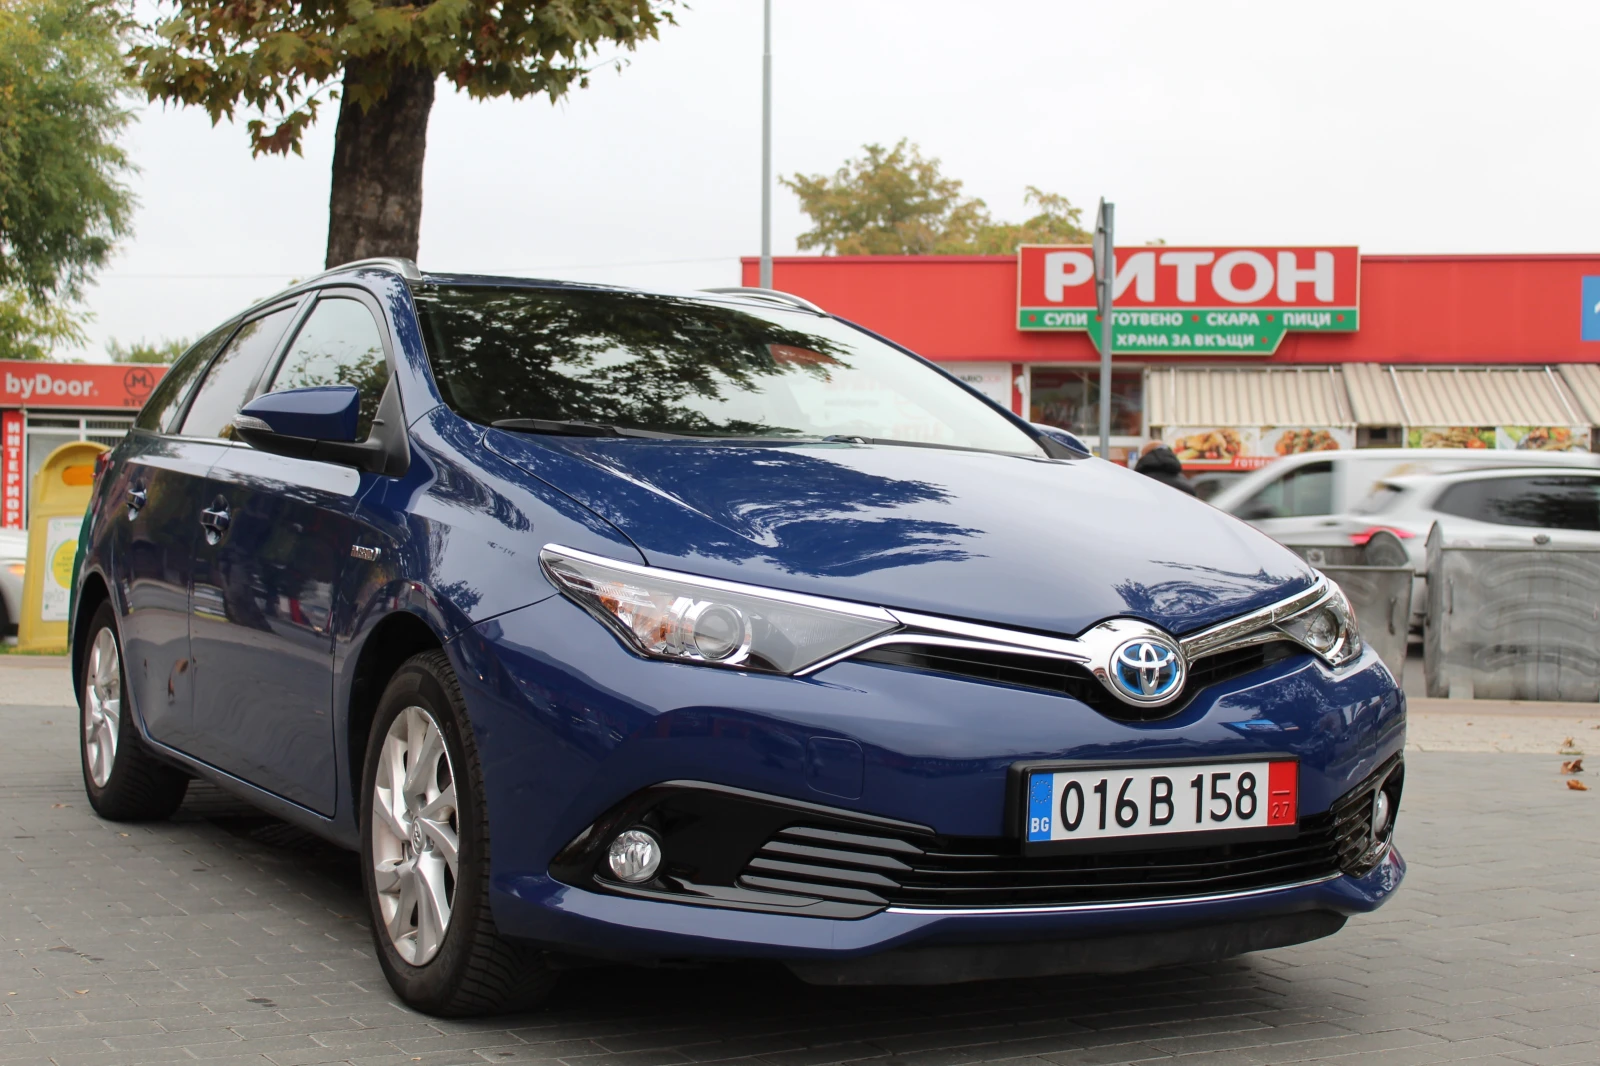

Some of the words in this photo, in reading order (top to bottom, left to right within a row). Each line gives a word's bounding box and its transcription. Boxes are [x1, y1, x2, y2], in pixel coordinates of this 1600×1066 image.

[1044, 251, 1335, 303] РИТОН
[1044, 312, 1088, 326] СУПИ
[1111, 312, 1183, 326] ГОТВЕНО
[1206, 312, 1260, 326] СКАРА
[1283, 312, 1331, 328] ПИЦИ
[1116, 334, 1169, 347] ХРАНА
[1172, 334, 1191, 346] ЗА
[1194, 334, 1254, 348] ВКЪЩИ
[1031, 817, 1049, 833] BG
[1060, 777, 1139, 832] 016
[1190, 771, 1258, 823] 158
[1272, 802, 1290, 819] 27
